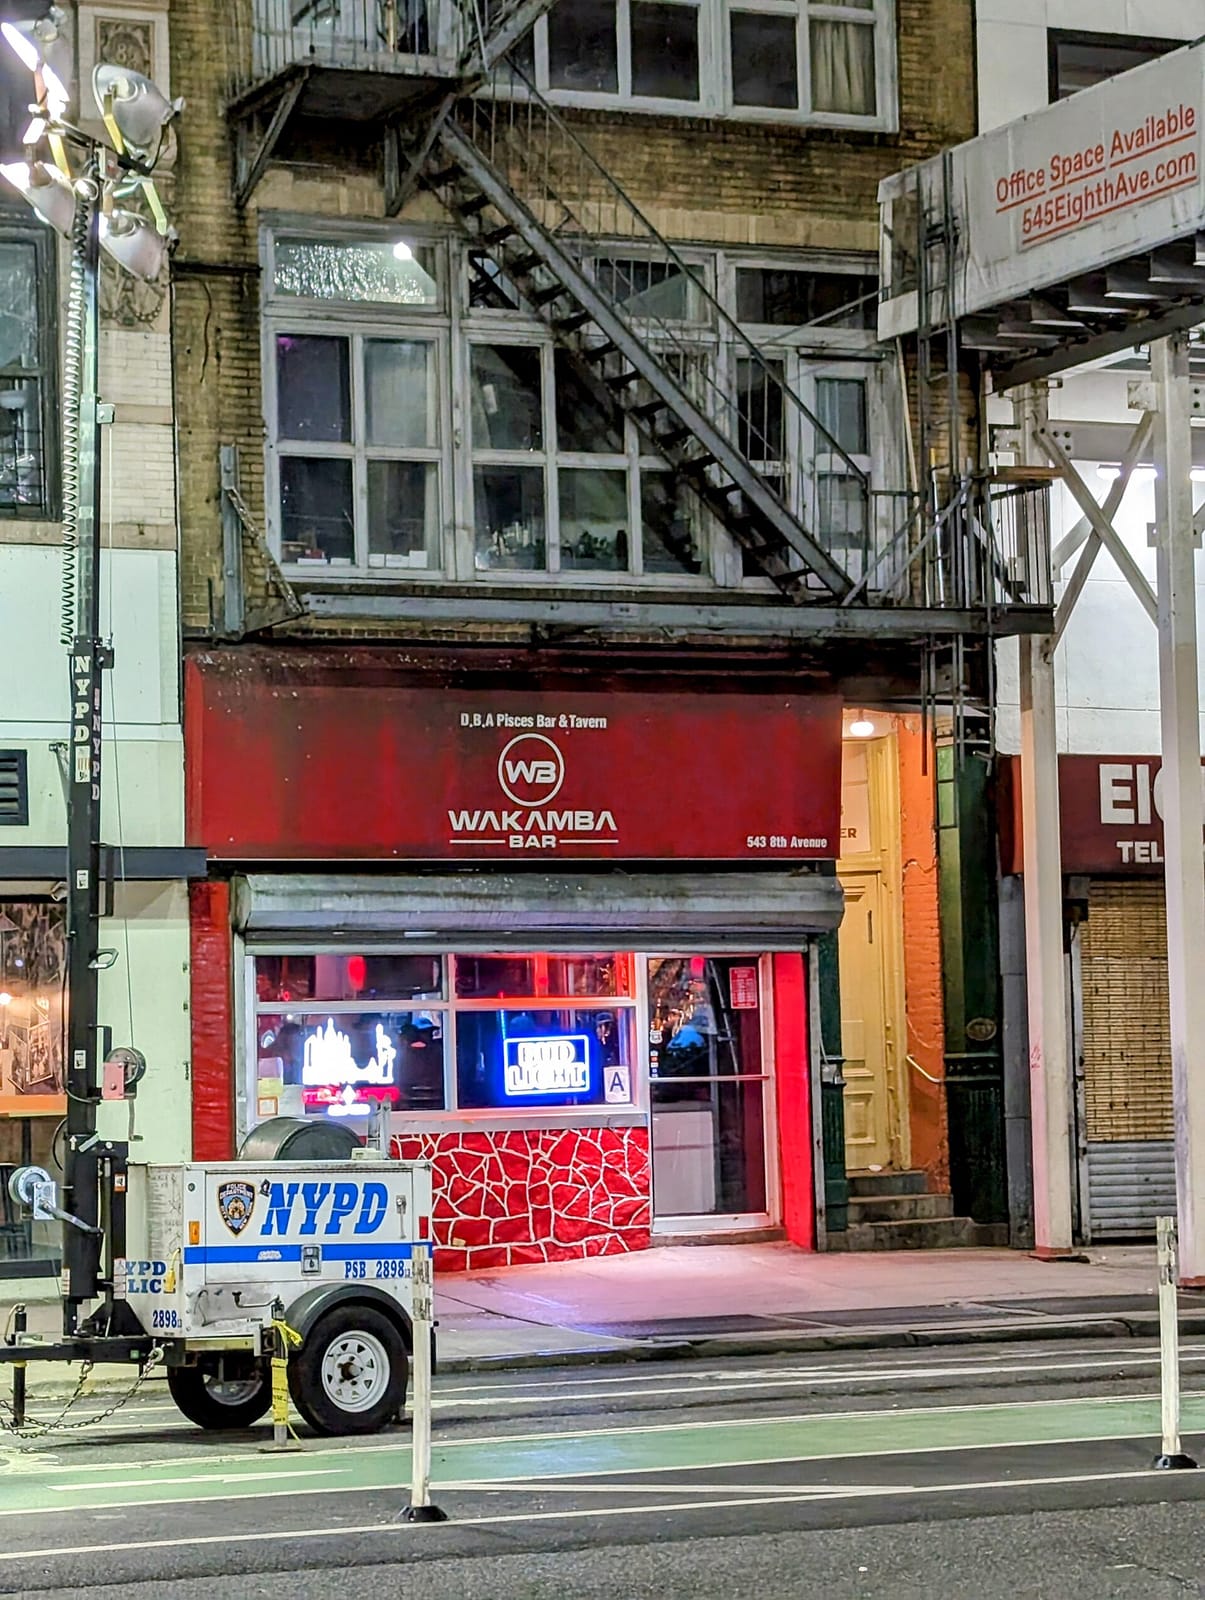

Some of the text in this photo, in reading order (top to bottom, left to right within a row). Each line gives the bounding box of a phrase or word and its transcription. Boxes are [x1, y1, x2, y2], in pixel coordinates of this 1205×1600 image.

[996, 103, 1195, 203] Office Space Available
[1022, 151, 1196, 234] 545EighthAve.com
[74, 655, 91, 743] NYPD
[460, 712, 607, 729] D.B.A Pisces Bar & Tavern
[91, 714, 101, 801] NYPD
[505, 760, 557, 784] WB
[448, 810, 618, 831] WAKAMBA
[509, 835, 557, 849] BAR
[747, 836, 828, 848] 543 8th Avenue
[609, 1071, 625, 1092] A
[260, 1182, 388, 1236] NYPD
[125, 1261, 167, 1276] YPD
[344, 1261, 366, 1279] PSB
[127, 1278, 176, 1294] LIC
